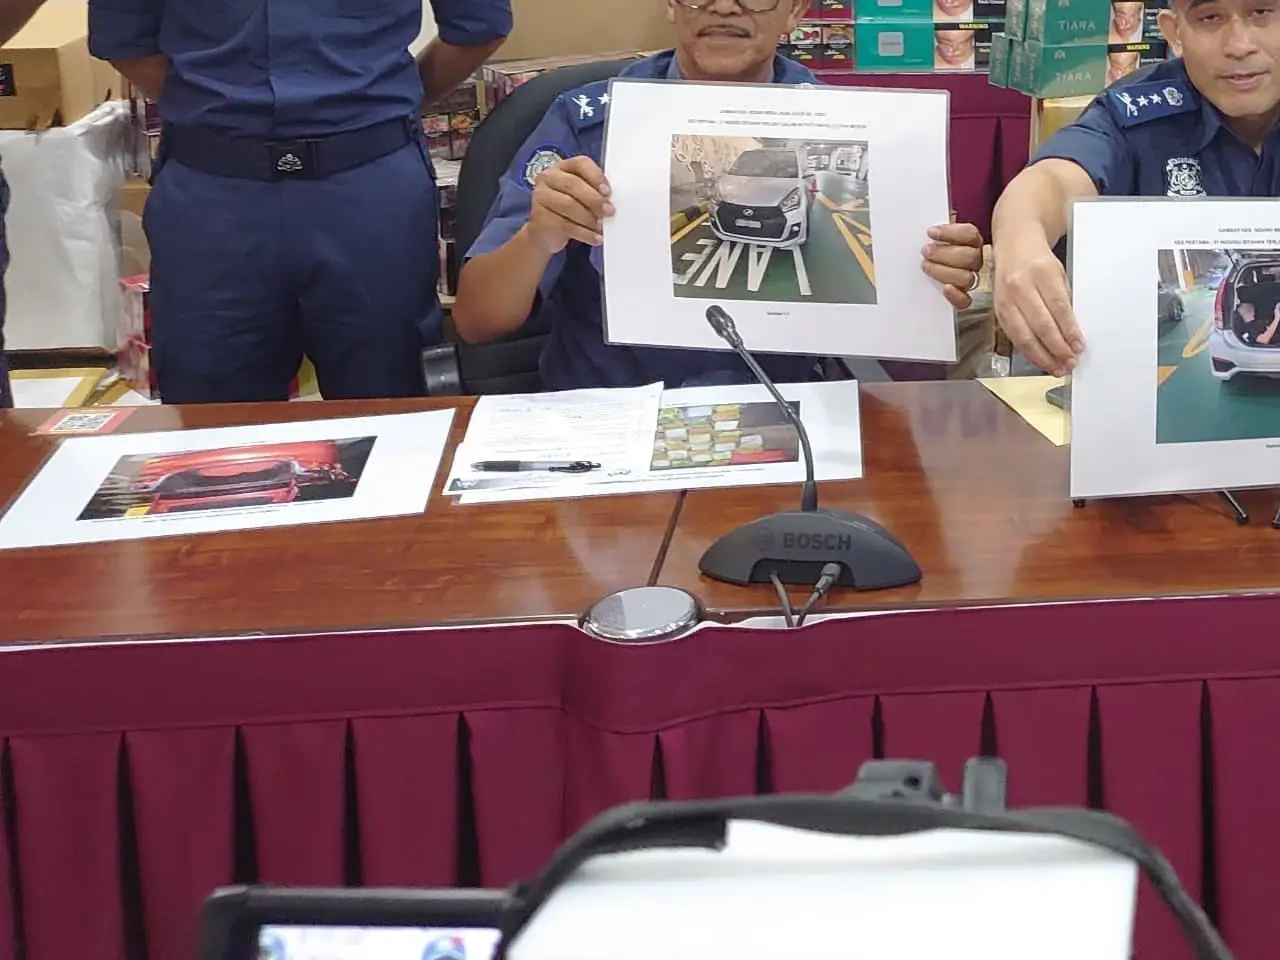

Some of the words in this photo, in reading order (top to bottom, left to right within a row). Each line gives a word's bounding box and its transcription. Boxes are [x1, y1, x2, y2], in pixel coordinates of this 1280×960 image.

[1058, 20, 1096, 31] TIARA
[1055, 72, 1092, 82] TIARA
[782, 532, 851, 551] BOSCH
